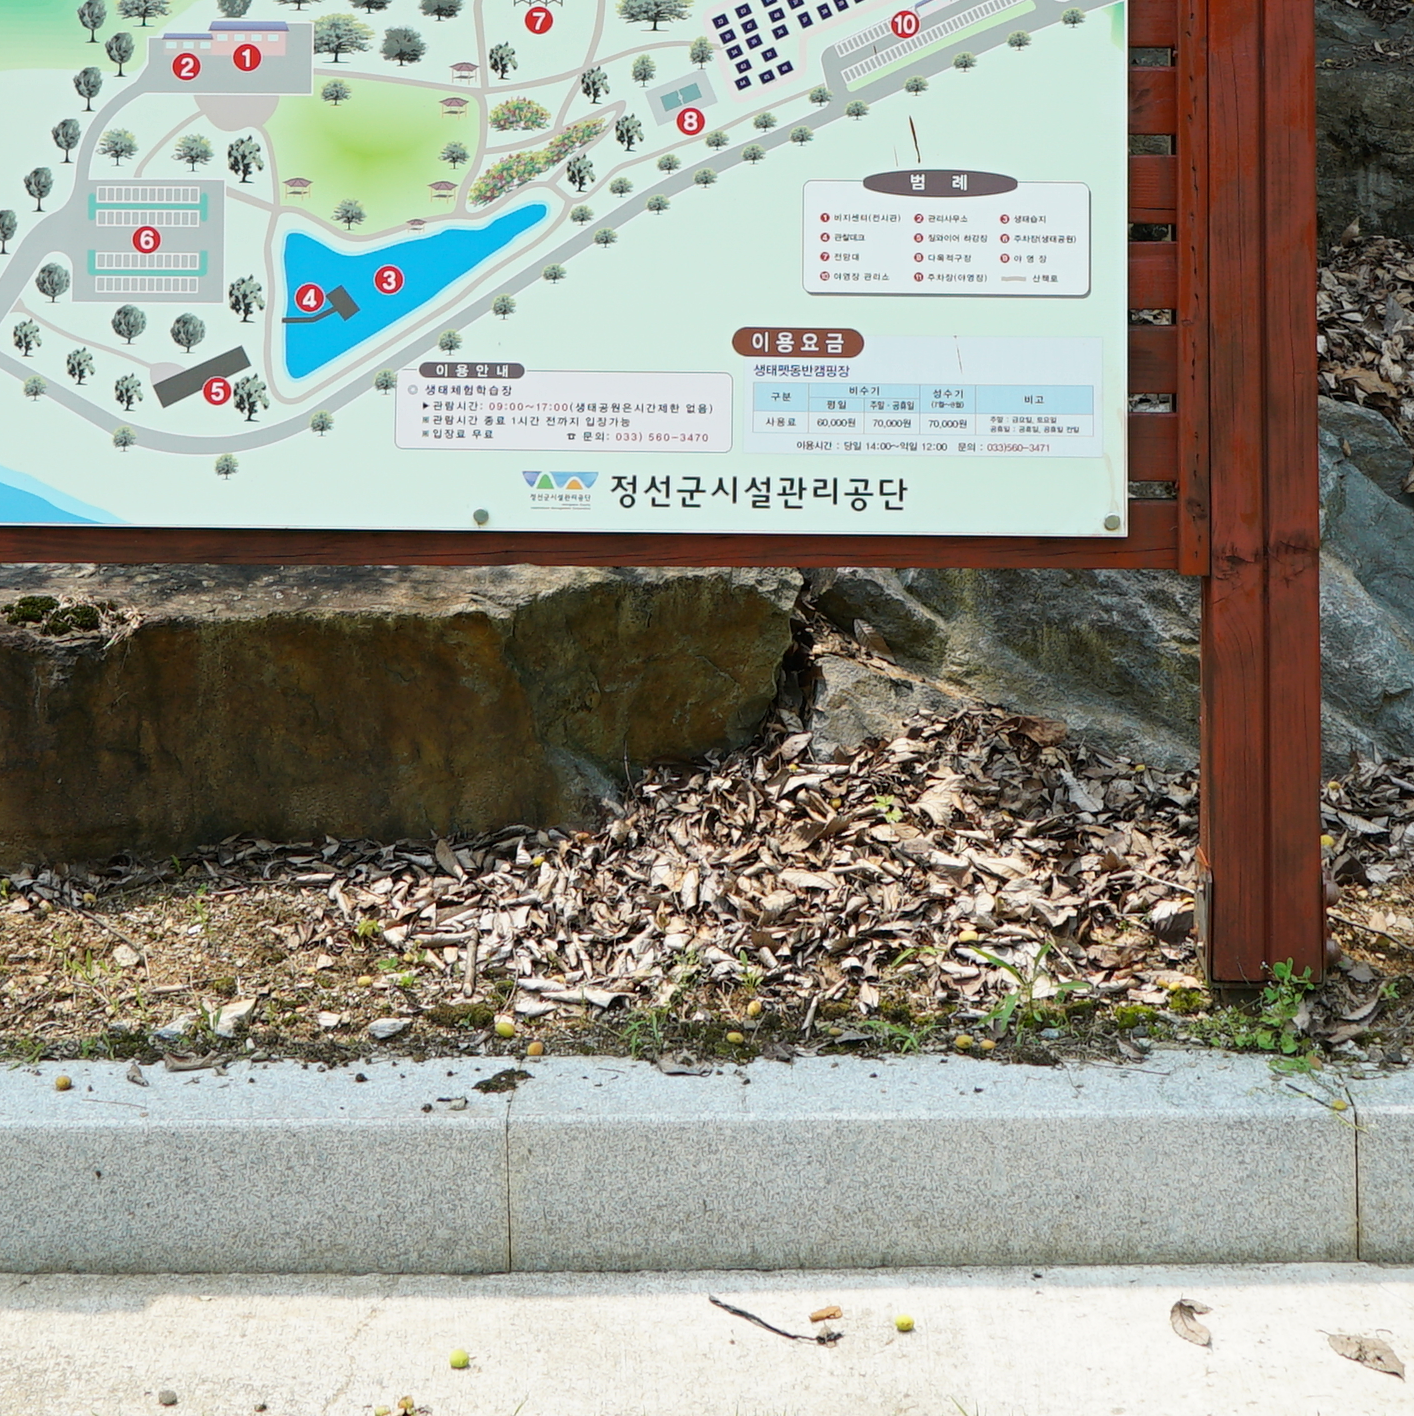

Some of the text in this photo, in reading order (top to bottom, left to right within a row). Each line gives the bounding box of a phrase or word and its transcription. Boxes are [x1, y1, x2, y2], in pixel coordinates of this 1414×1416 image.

[533, 12, 545, 30] 7
[894, 14, 916, 34] 10
[242, 49, 250, 67] 1
[181, 58, 194, 76] 2
[684, 112, 697, 130] 8
[911, 174, 967, 190] 범 례
[140, 230, 154, 249] 6
[835, 253, 859, 261] 전망대
[383, 271, 396, 290] 3
[303, 289, 316, 307] 4
[753, 332, 844, 353] 이용요금
[436, 364, 508, 377] 이용안내
[754, 365, 849, 377] 생태펫동반캠핑장
[211, 382, 224, 401] 5
[426, 385, 511, 396] 생태체험학습장
[771, 392, 791, 401] 구분
[849, 386, 879, 395] 비수기
[933, 389, 963, 399] 성수기
[827, 400, 846, 410] 평일
[1025, 395, 1043, 404] 비고
[434, 401, 482, 411] 관람시간:
[686, 404, 712, 414] 없음)
[433, 416, 630, 427] 관람시간 종료 1시간 전까지 입장가능
[766, 418, 795, 426] 사용료
[817, 418, 855, 427] 60,000원
[874, 419, 911, 428] 70,000원
[929, 419, 967, 428] 70,000원
[433, 429, 465, 439] 입장료
[473, 430, 493, 438] 무료
[649, 433, 708, 442] 560-3470
[797, 441, 832, 450] 이용시간
[844, 442, 861, 450] 당일
[923, 443, 947, 451] 12:00
[959, 443, 975, 452] 문의
[987, 443, 1049, 452] 033)560-3471
[611, 475, 907, 511] 정선군시설관리공단
